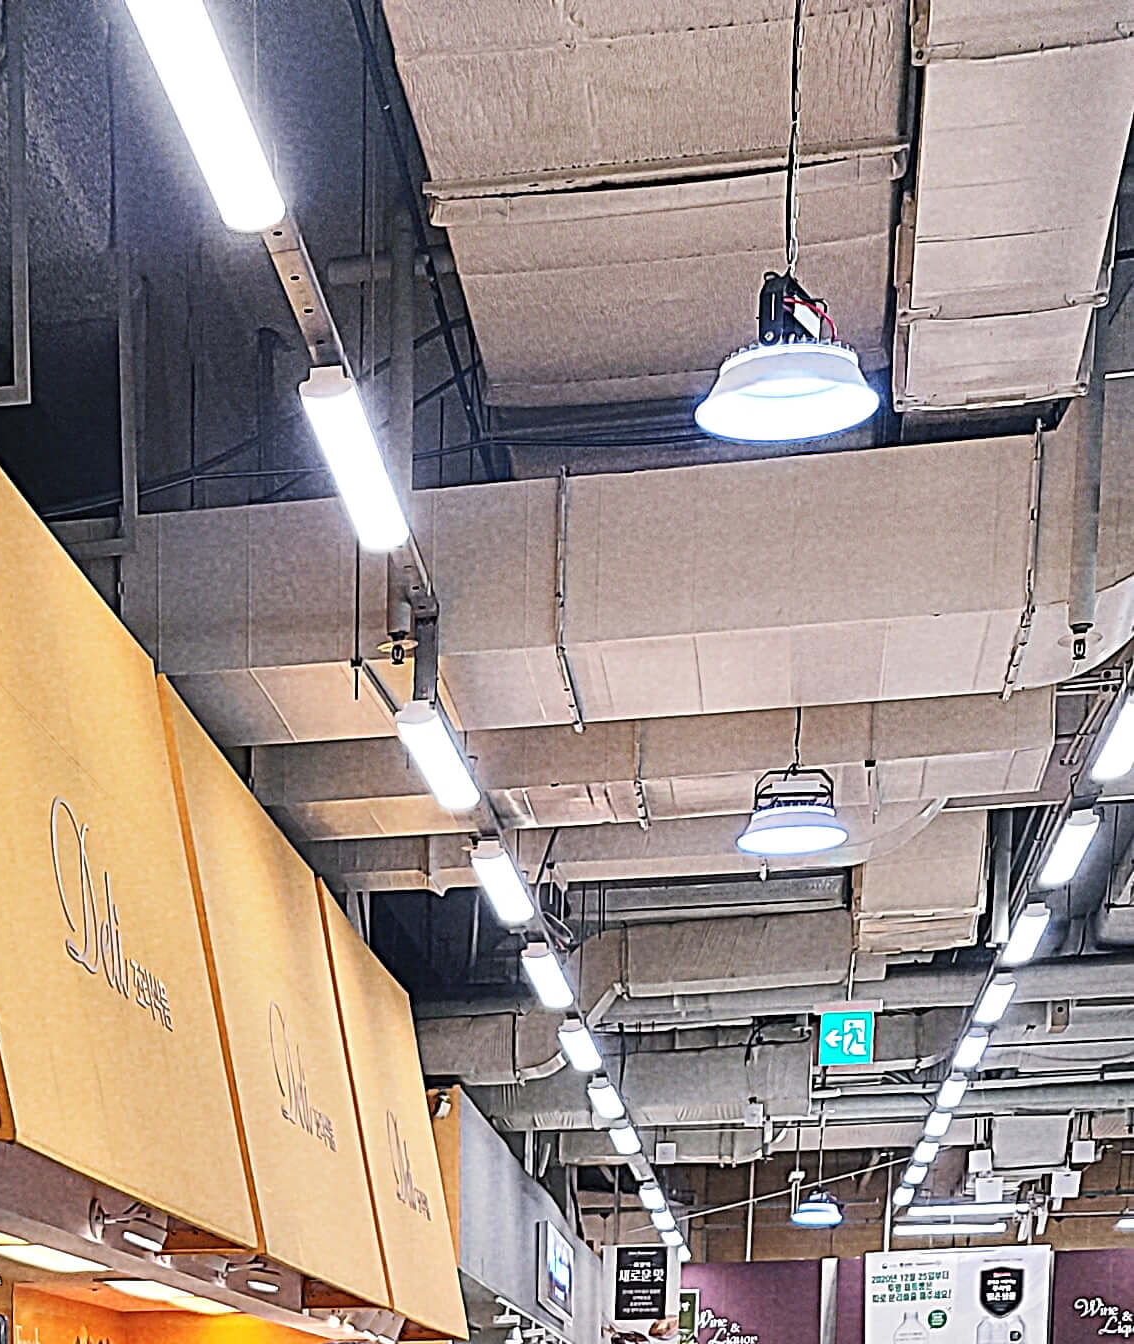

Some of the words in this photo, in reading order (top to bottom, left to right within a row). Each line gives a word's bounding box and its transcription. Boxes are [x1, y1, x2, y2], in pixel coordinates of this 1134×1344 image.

[50, 796, 129, 999] Deli
[619, 1269, 652, 1283] 새로운
[653, 1268, 665, 1282] 맛
[698, 1309, 728, 1329] Wine
[730, 1322, 742, 1333] &
[1074, 1297, 1119, 1318] Wine
[1121, 1311, 1133, 1323] &
